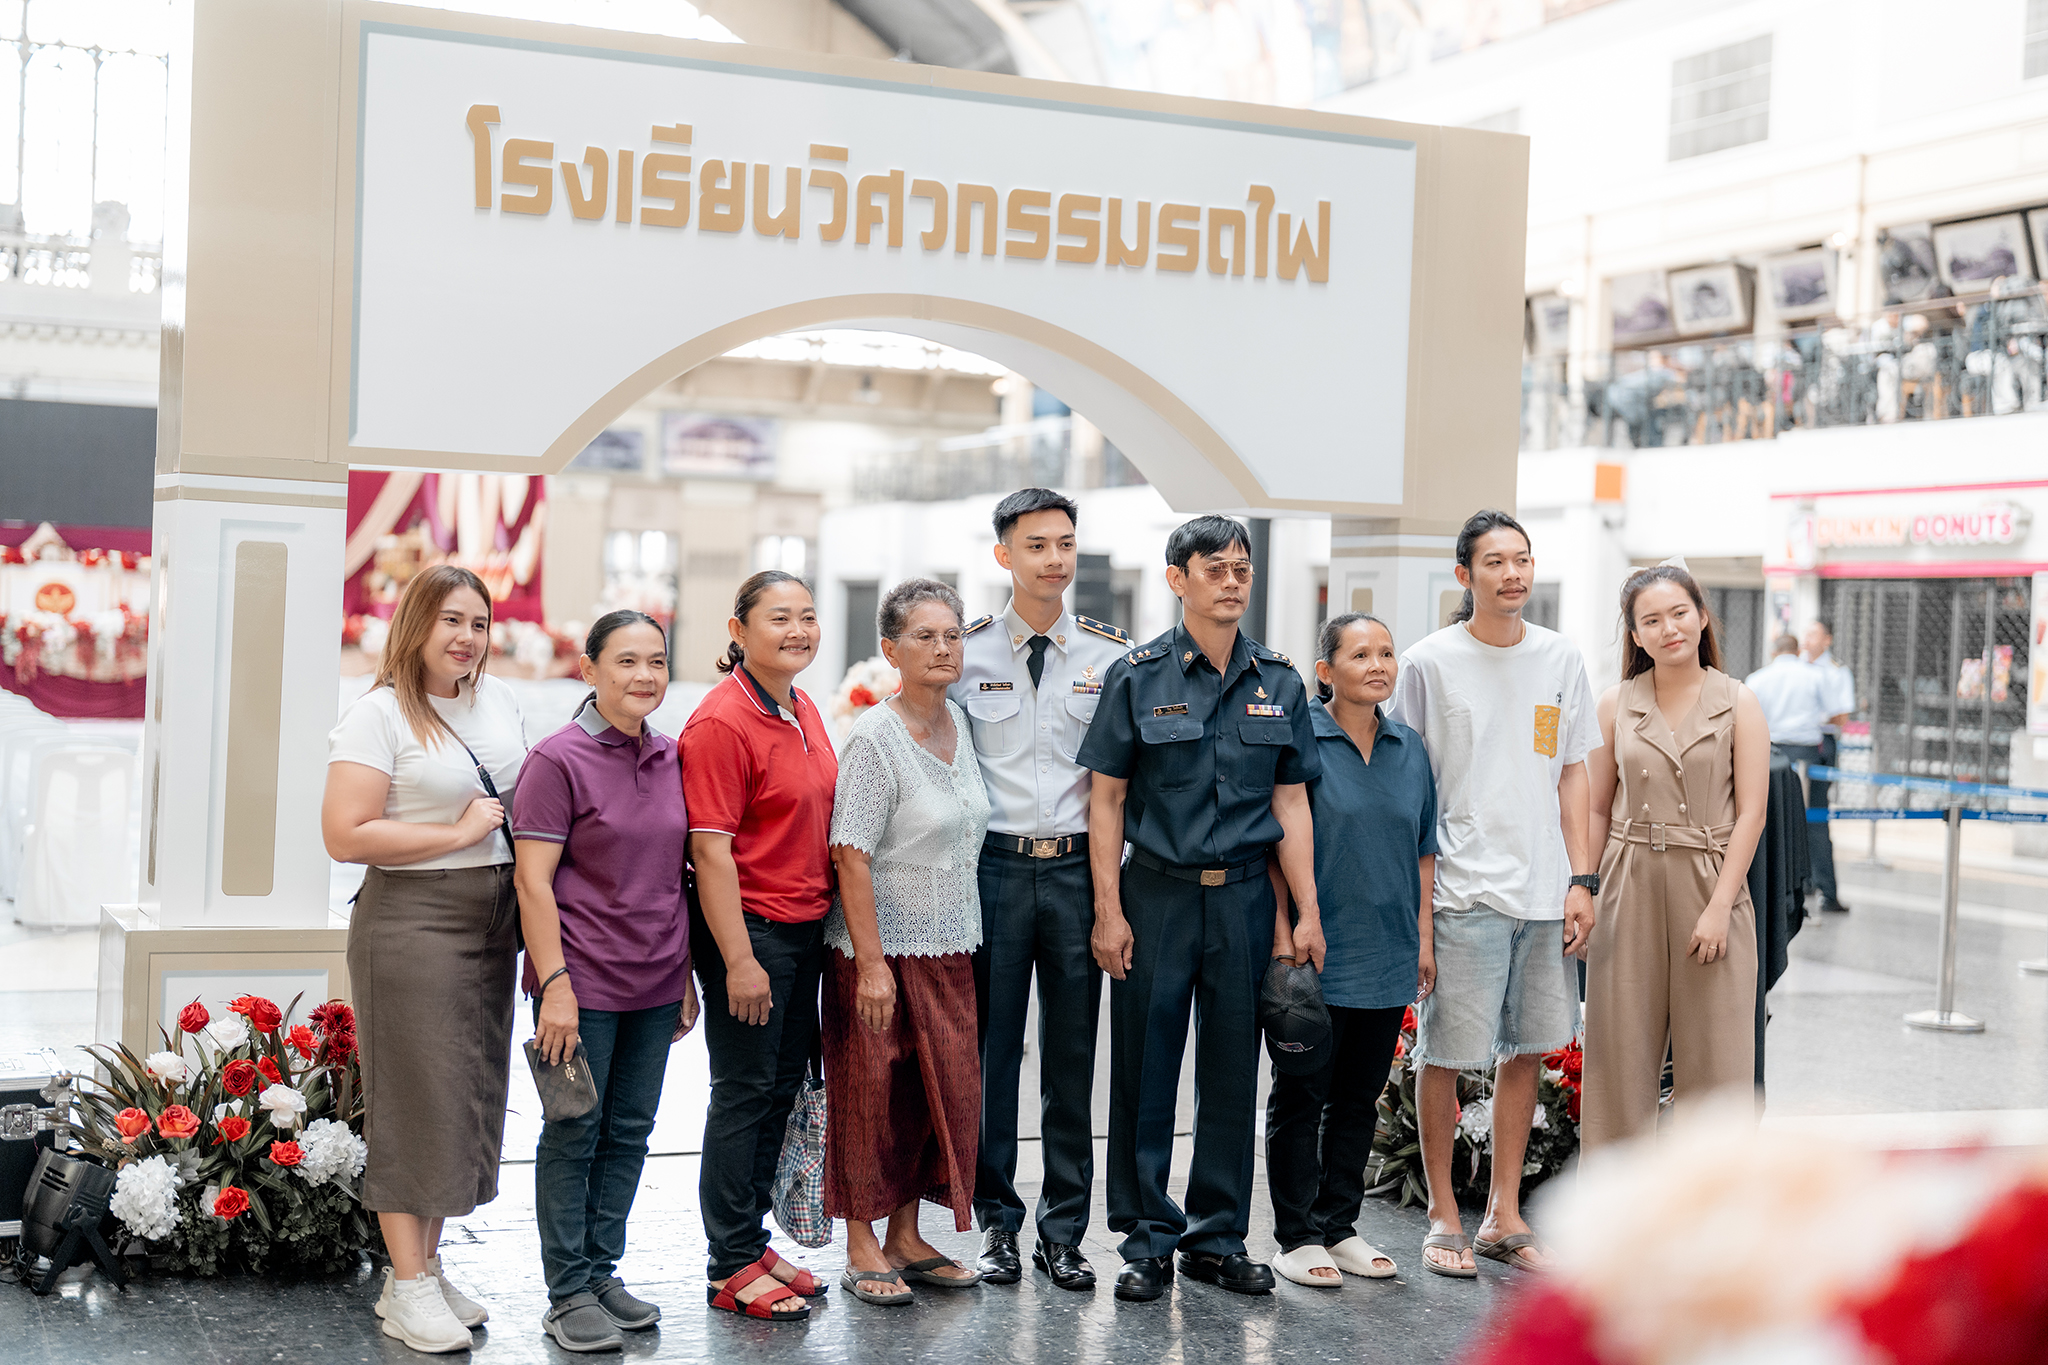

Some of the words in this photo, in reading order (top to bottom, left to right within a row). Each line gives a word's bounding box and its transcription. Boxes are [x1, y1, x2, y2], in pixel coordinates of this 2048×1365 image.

[466, 104, 1332, 283] โรงเรียนวิศวกรรมรถไฟ
[1911, 513, 2013, 541] DONUTS
